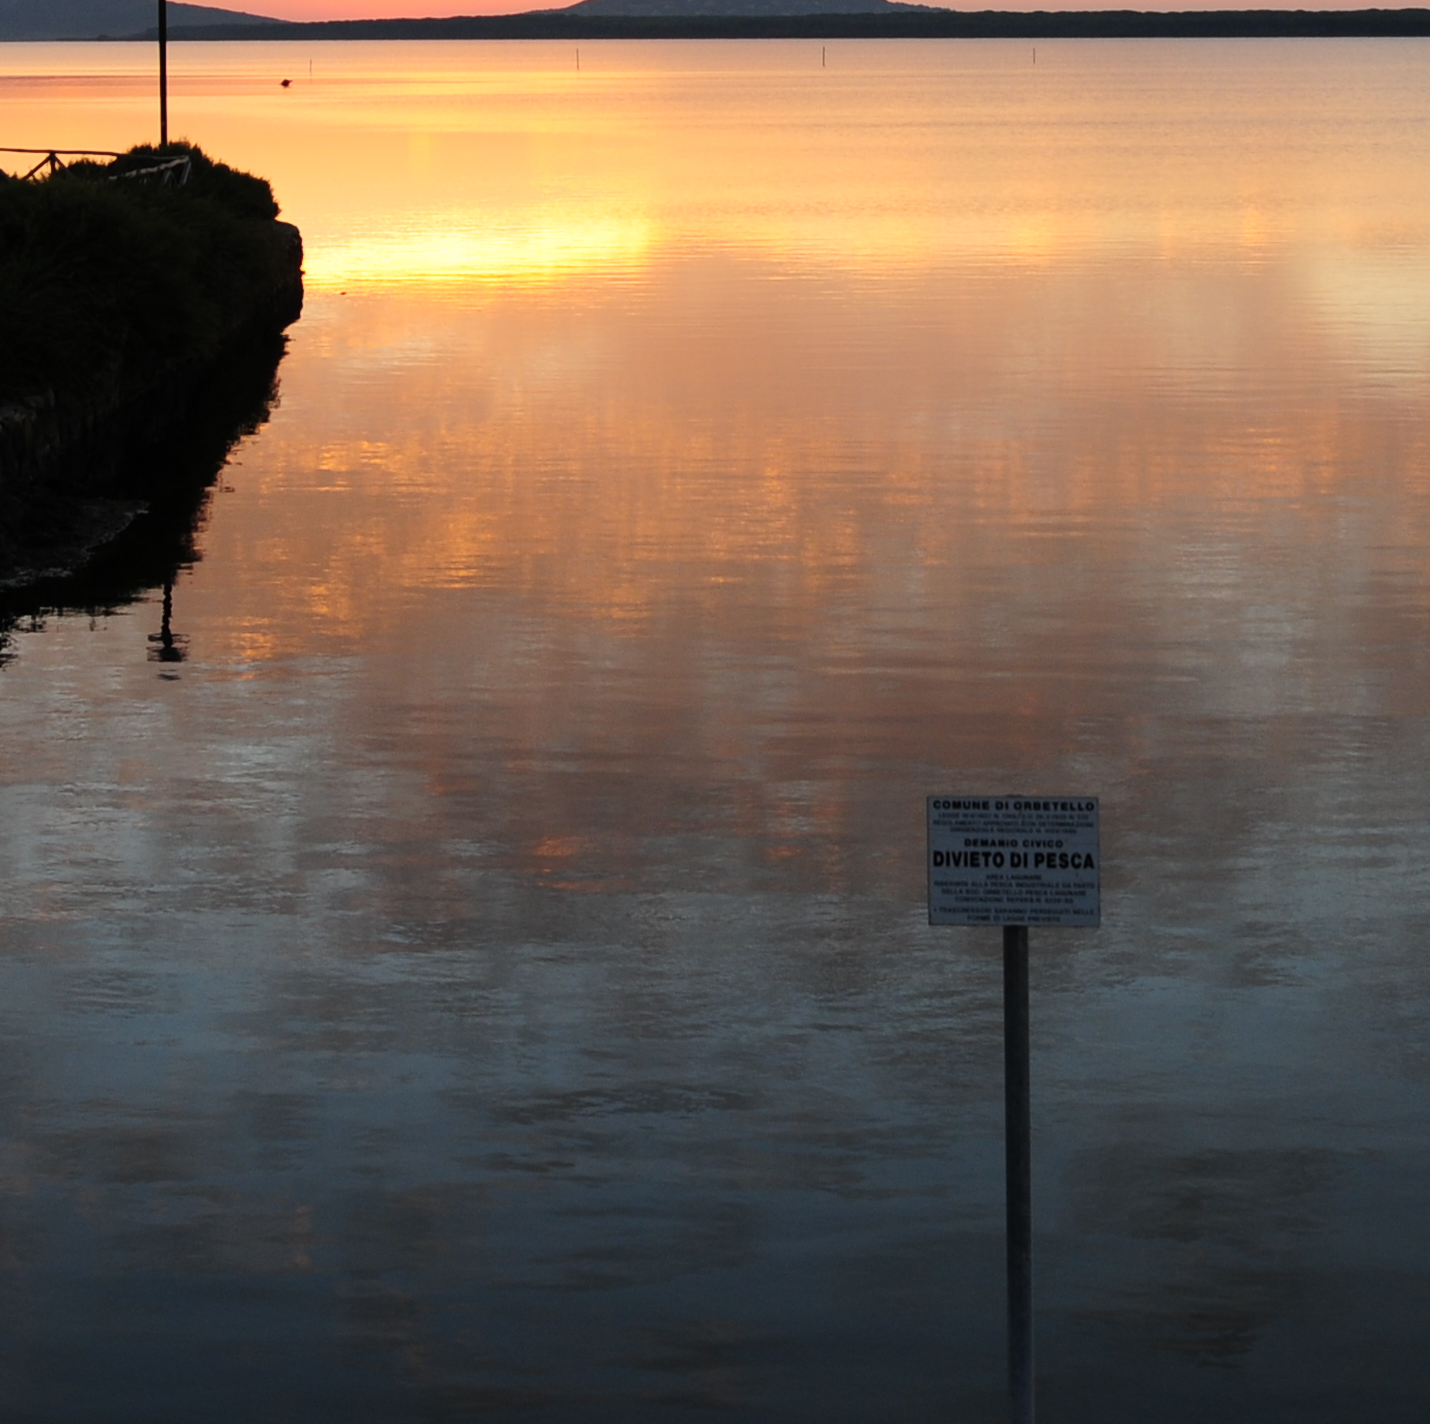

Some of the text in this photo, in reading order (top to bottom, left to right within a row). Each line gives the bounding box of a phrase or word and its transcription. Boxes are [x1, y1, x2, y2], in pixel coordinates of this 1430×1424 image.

[933, 800, 1095, 811] COMUNE DI ORBETELLO
[964, 838, 1064, 848] DEMANIO CIVICO
[933, 850, 1094, 869] DIVIETO DI PESCA
